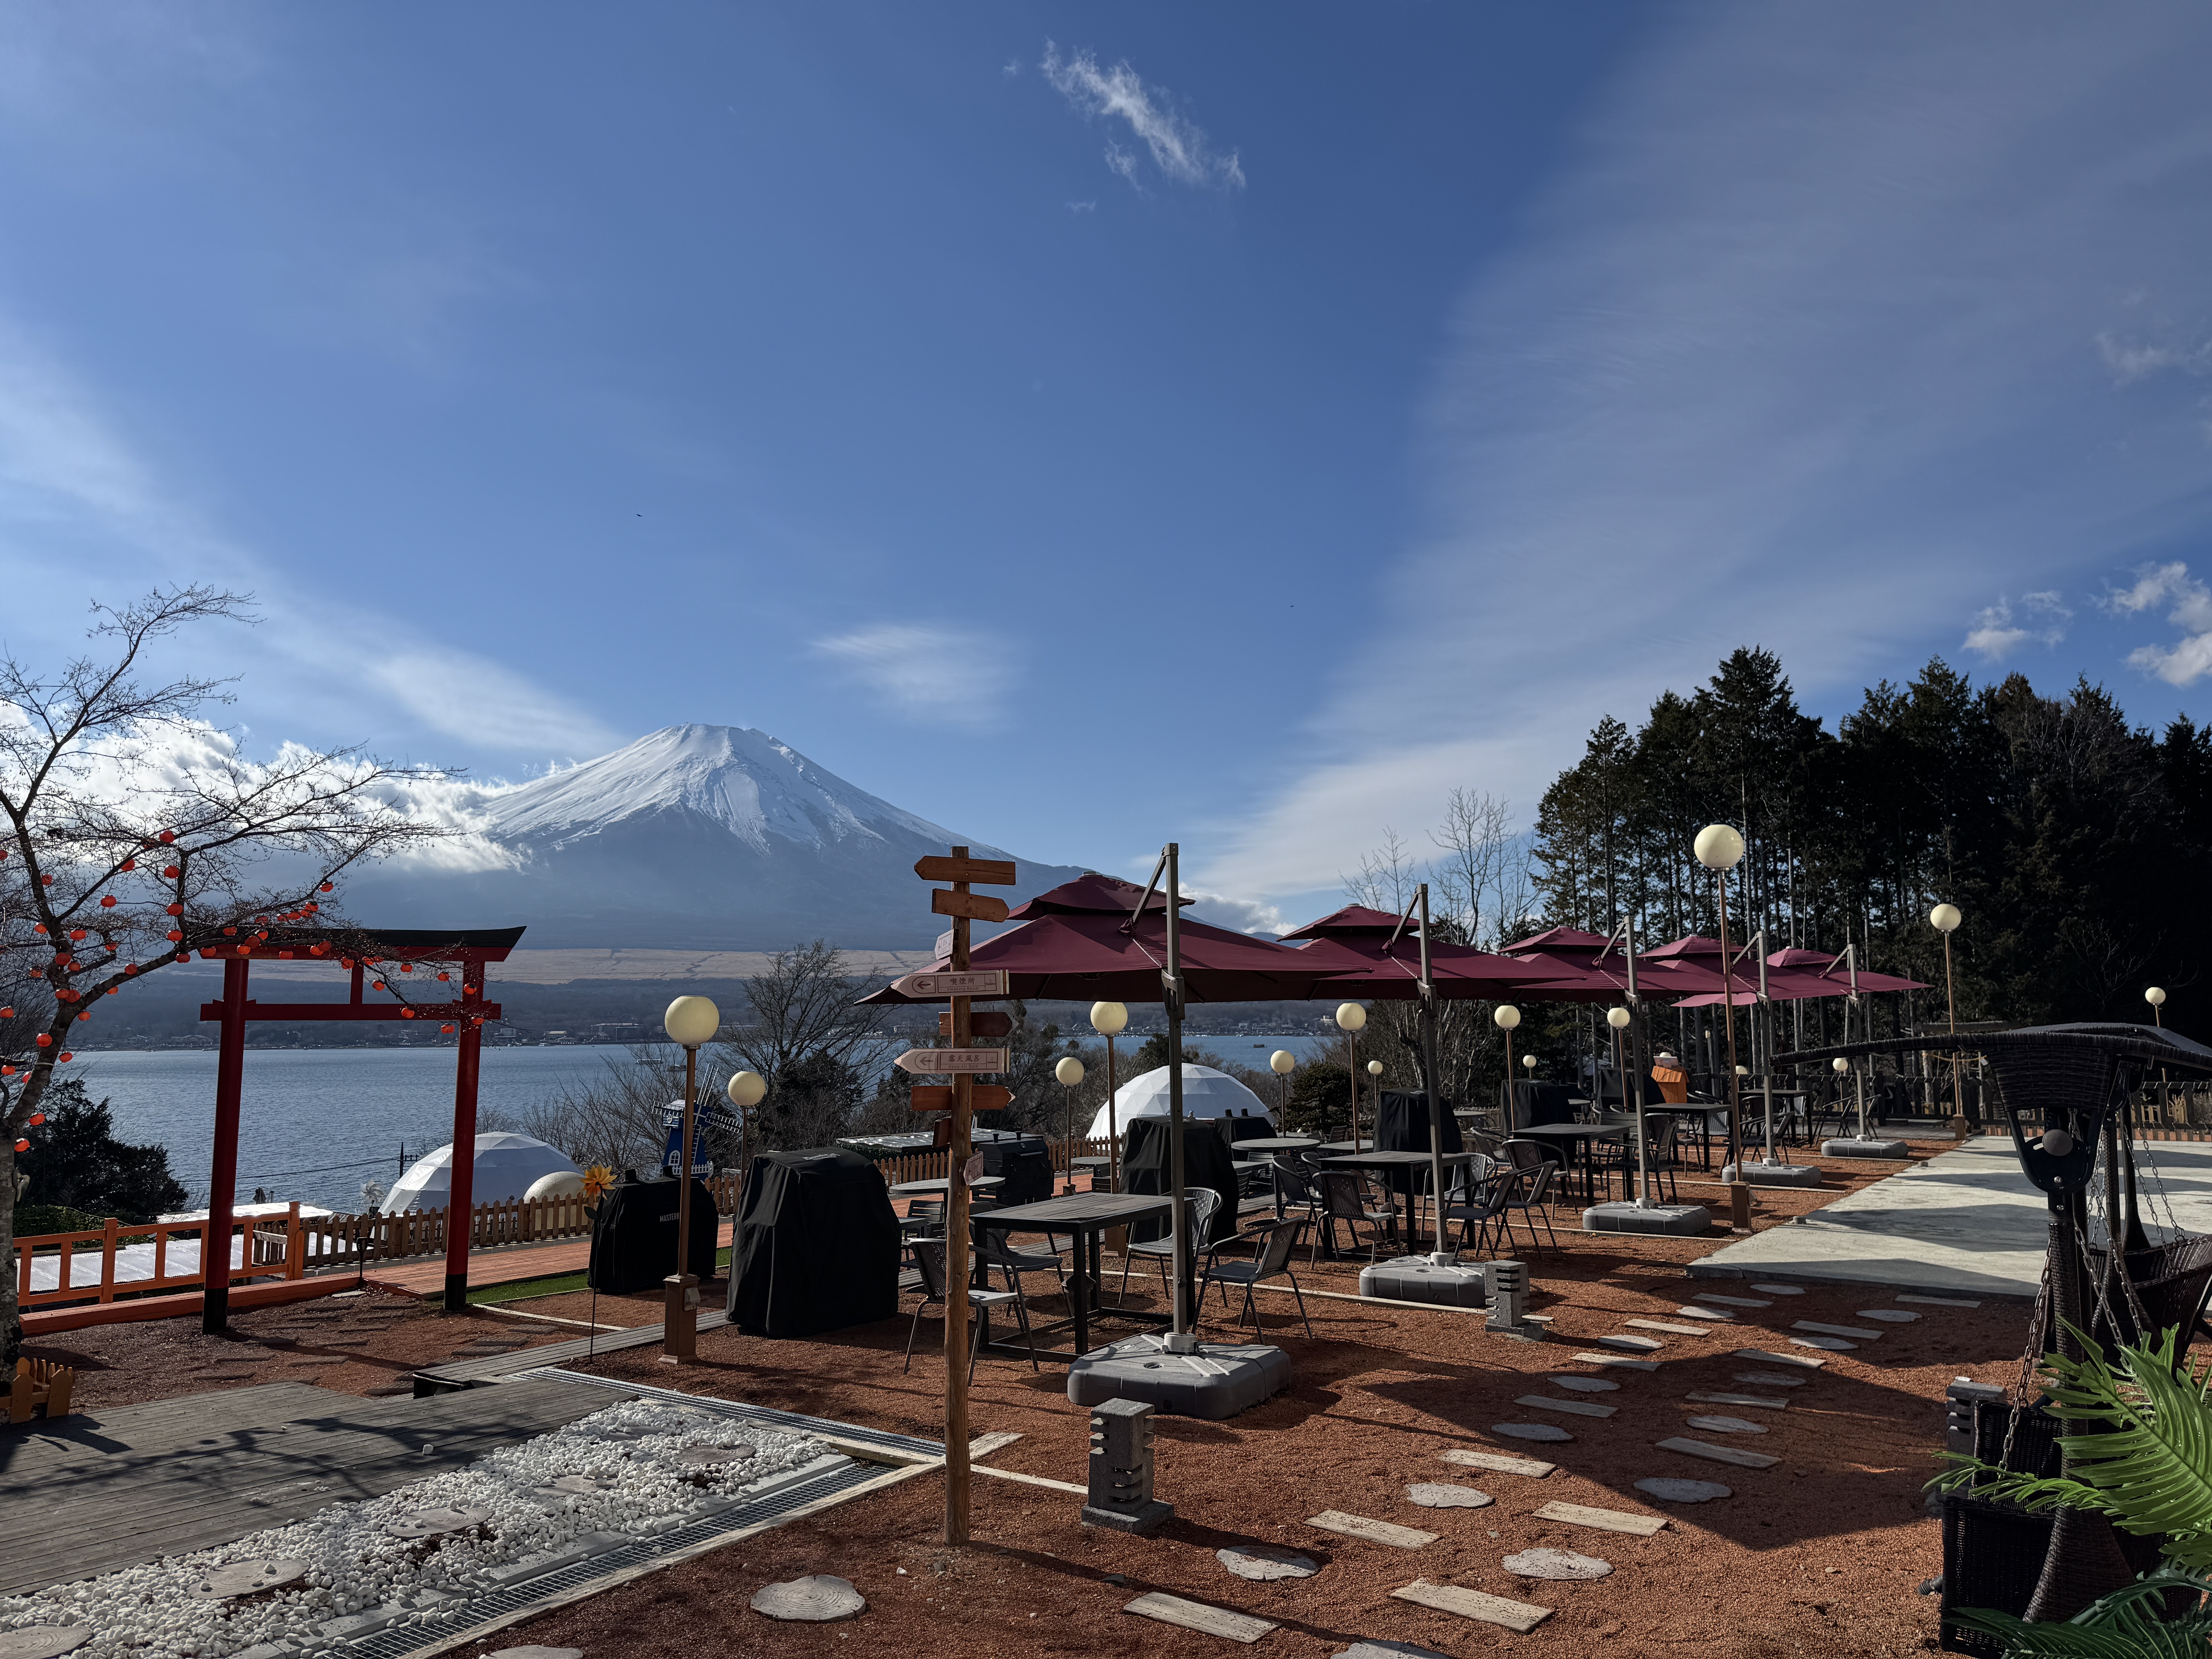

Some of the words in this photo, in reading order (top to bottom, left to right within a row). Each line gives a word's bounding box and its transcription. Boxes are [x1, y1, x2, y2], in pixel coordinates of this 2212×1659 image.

[950, 977, 975, 985] 喫煙所
[660, 1212, 680, 1222] MASTERB
